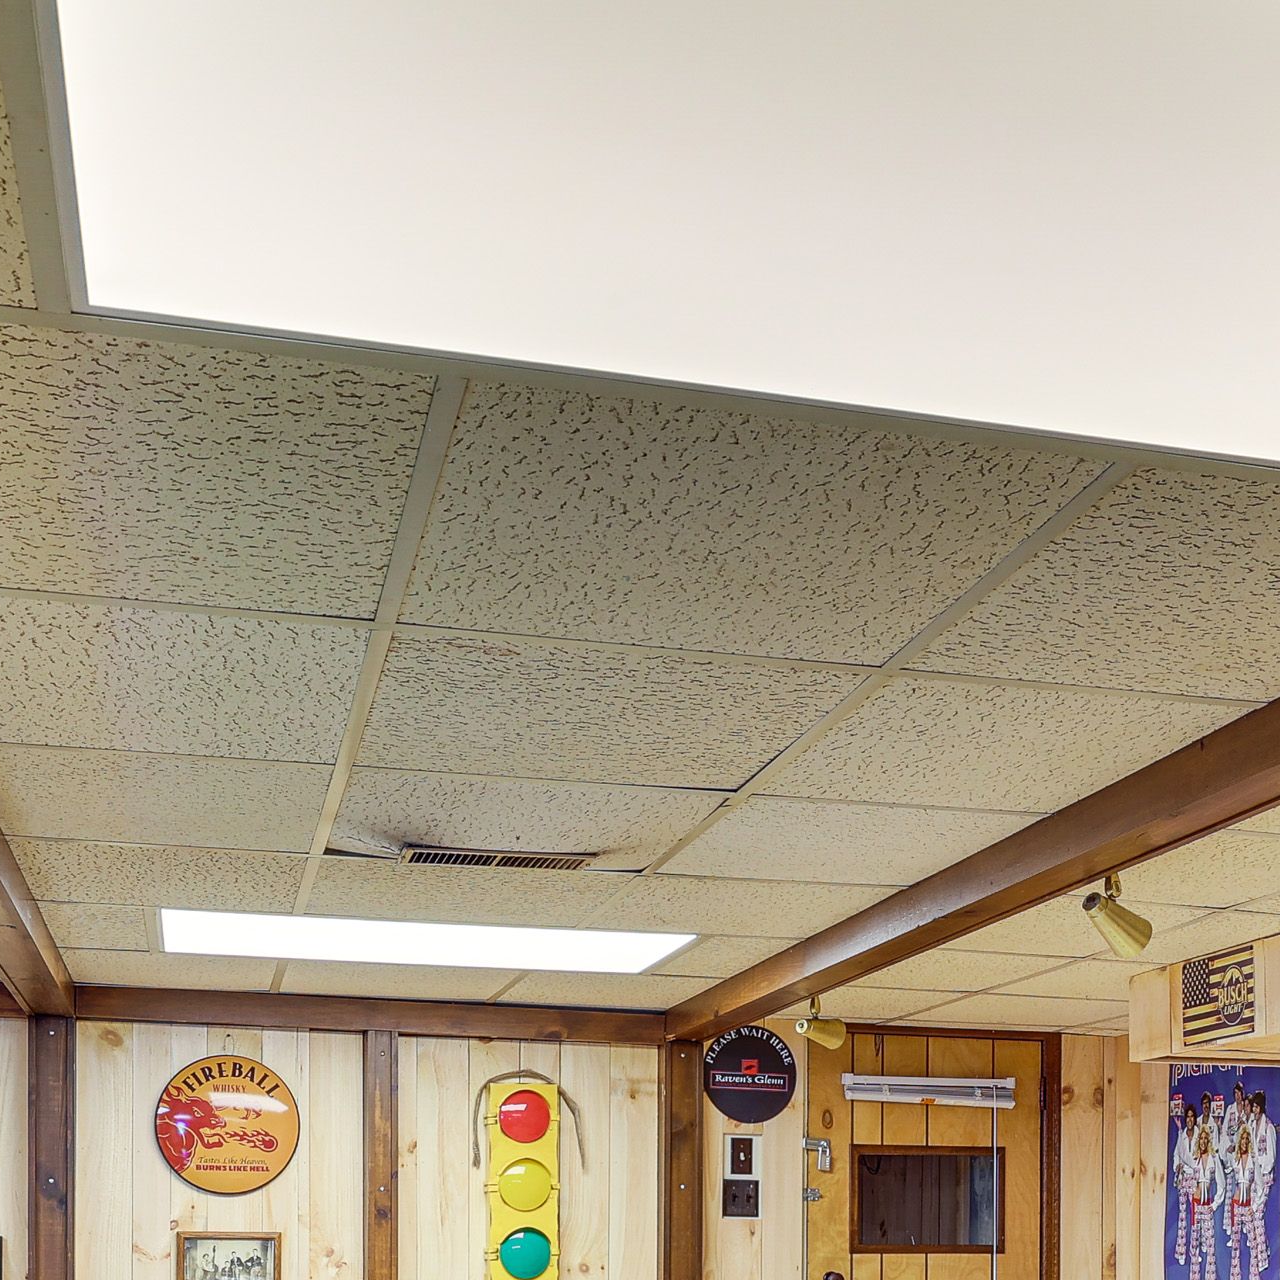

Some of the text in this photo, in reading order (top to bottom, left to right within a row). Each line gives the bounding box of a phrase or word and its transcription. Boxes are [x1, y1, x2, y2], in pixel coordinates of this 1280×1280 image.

[1218, 980, 1248, 1006] BUSCH
[1224, 1002, 1244, 1015] LIGHT
[705, 1027, 793, 1066] PLEASE WAIT HERE
[181, 1061, 280, 1098] FIREBALL
[715, 1074, 784, 1085] Raven's Glenn
[212, 1084, 247, 1093] WHISKY
[198, 1156, 221, 1165] Tastes
[222, 1157, 240, 1165] Like
[195, 1164, 227, 1172] BURNS
